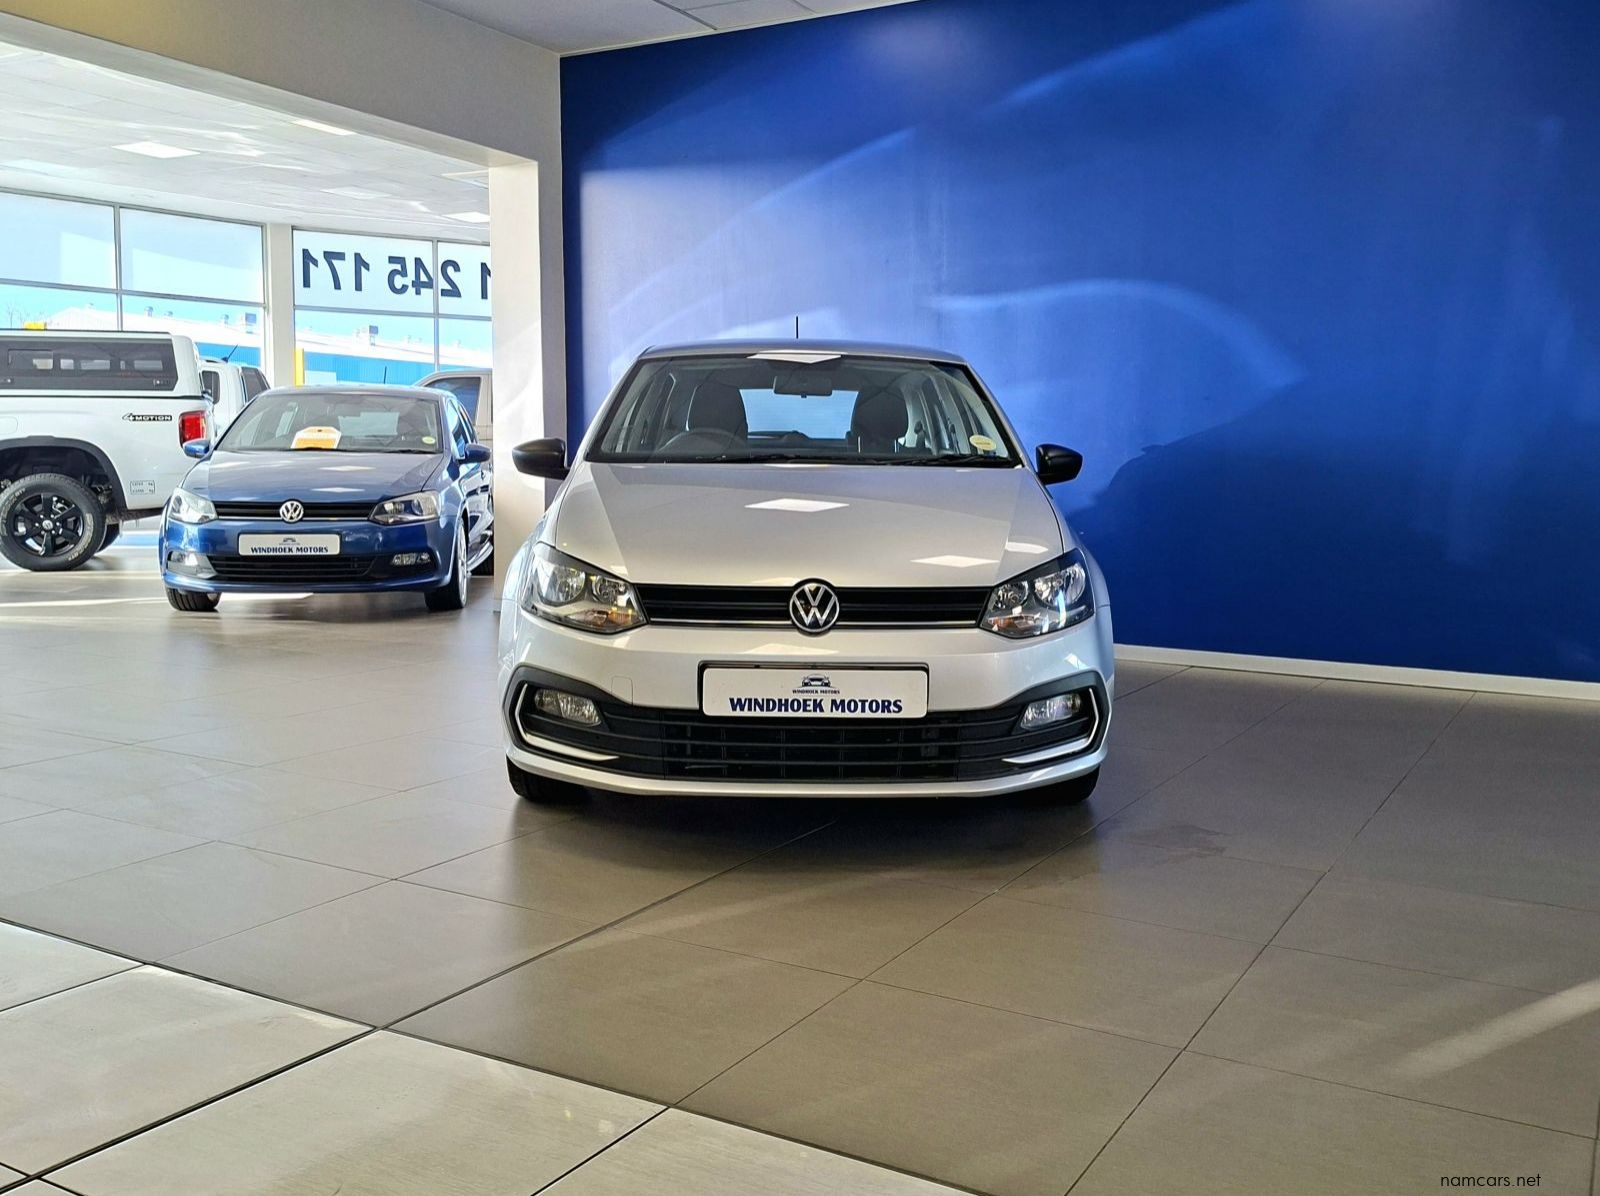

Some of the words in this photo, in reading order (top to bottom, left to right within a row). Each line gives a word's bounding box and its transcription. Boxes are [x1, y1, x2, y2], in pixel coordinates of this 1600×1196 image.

[122, 413, 173, 422] 4MOTION
[250, 546, 294, 554] WINDHOEK
[295, 546, 329, 554] MOTORS
[790, 582, 839, 630] VW
[729, 697, 825, 714] WINDHOEK
[830, 698, 903, 714] MOTORS
